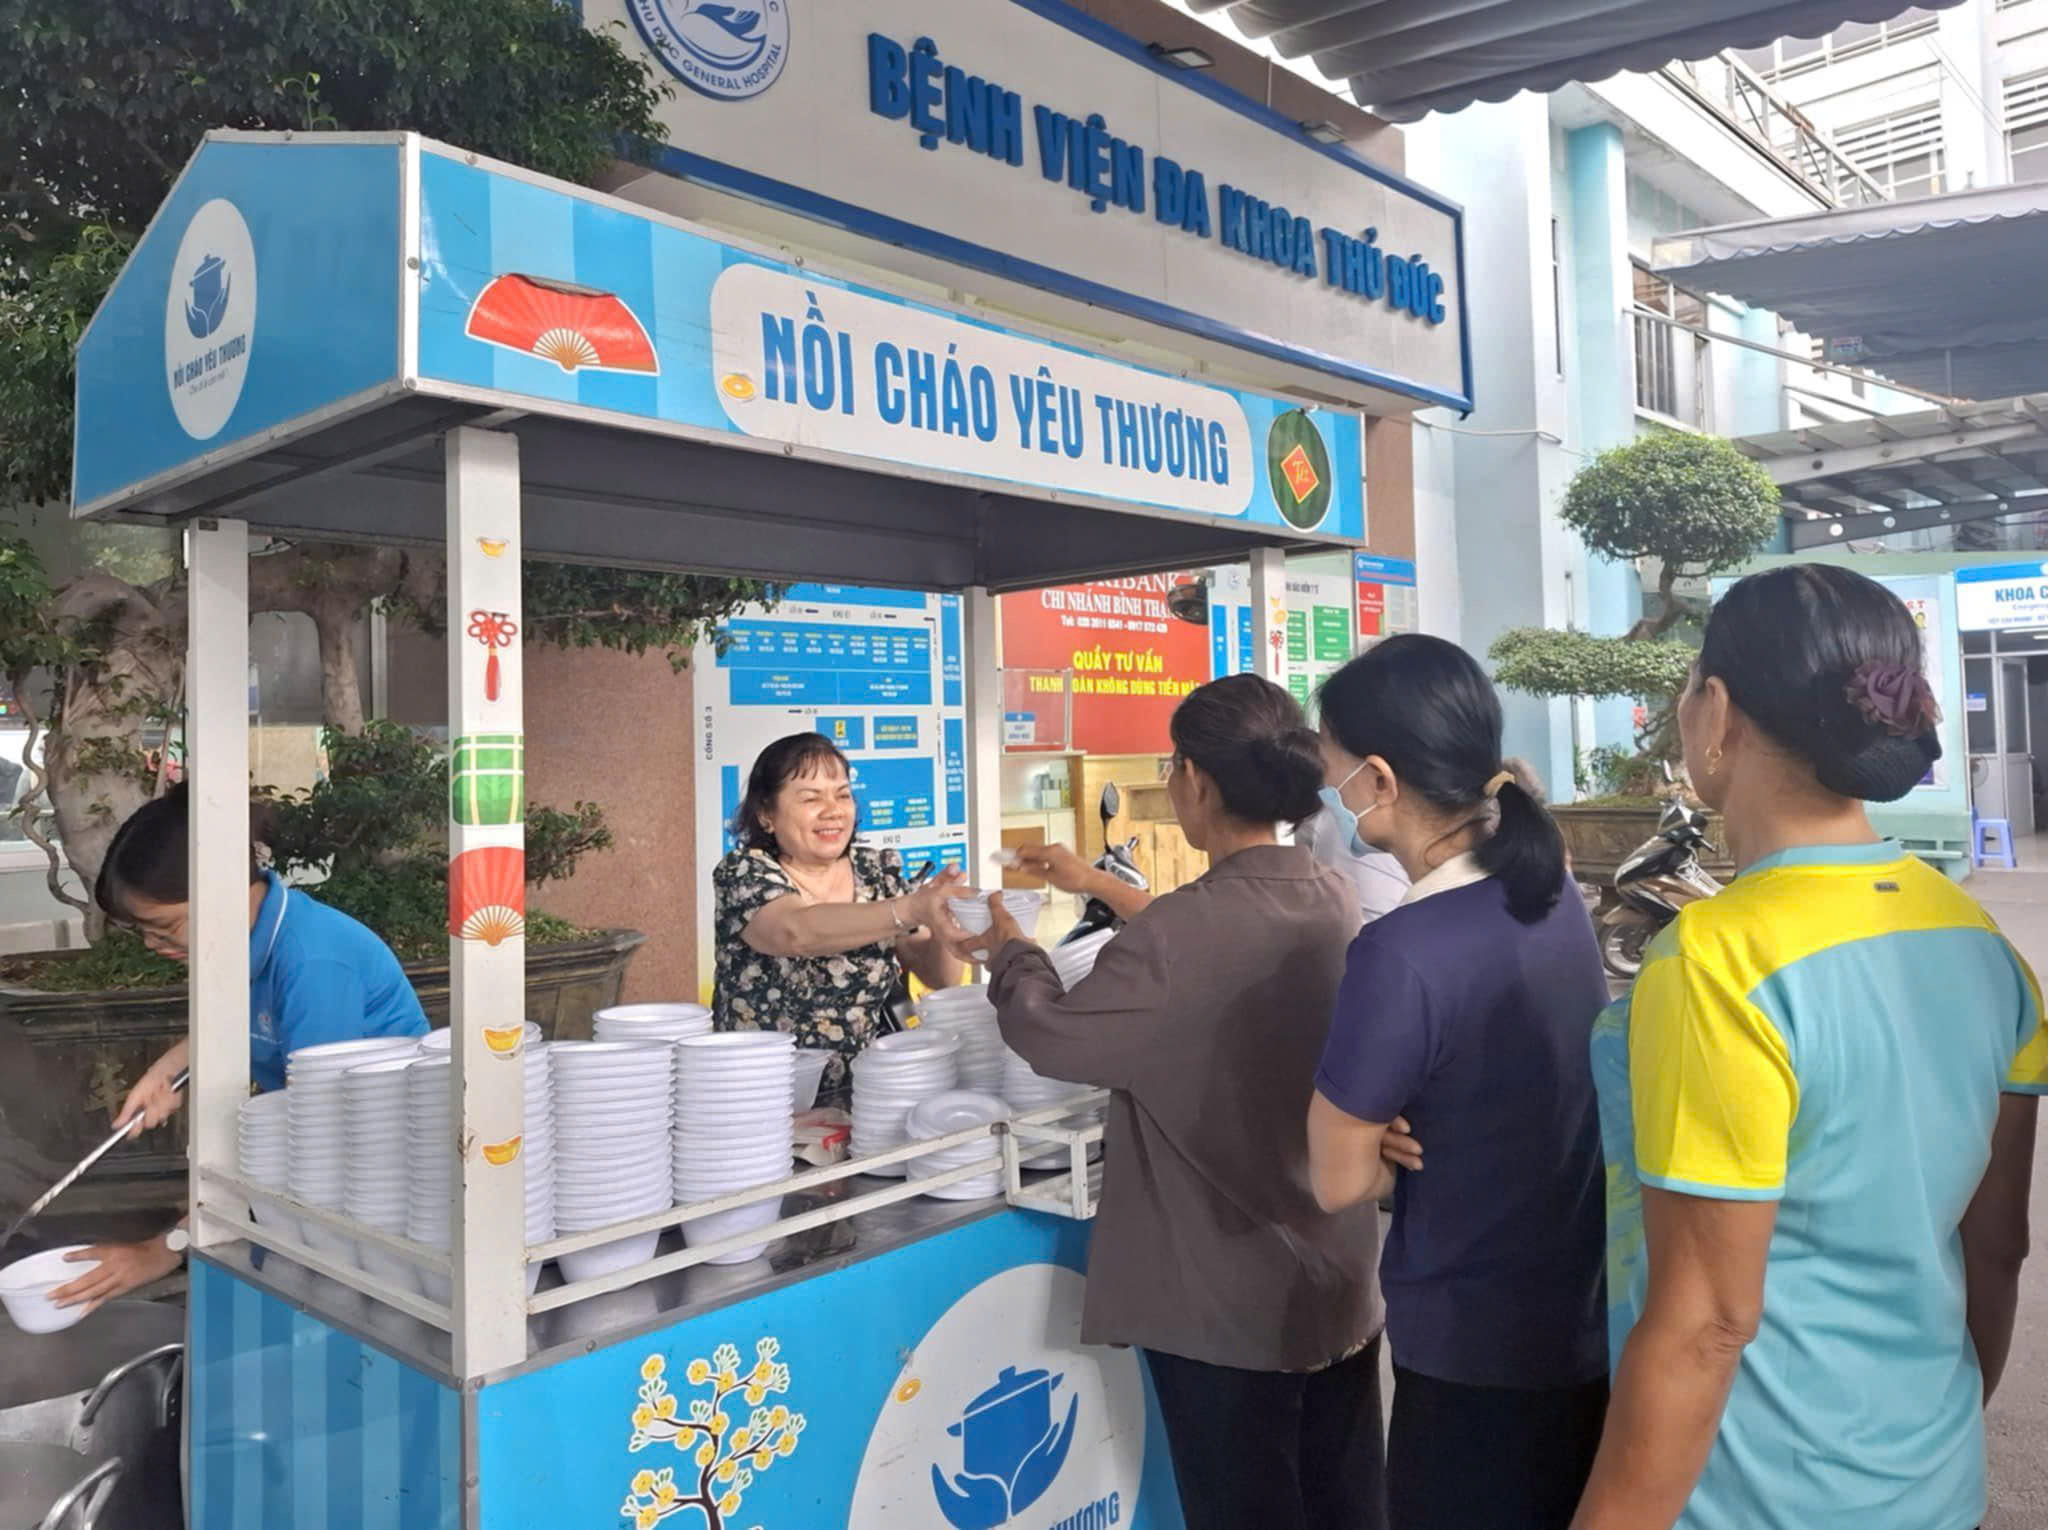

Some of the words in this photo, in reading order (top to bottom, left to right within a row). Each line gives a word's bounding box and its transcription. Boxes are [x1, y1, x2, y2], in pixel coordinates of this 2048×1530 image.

[682, 59, 741, 90] GENERAL
[743, 43, 781, 87] HOSPITAL
[867, 32, 1024, 167] BỆNH
[1033, 104, 1146, 214] VIỆN
[1152, 155, 1212, 239] ĐA
[1218, 184, 1319, 279] KHOA
[1320, 226, 1385, 300] THỦ
[1384, 254, 1446, 326] ĐỨC
[761, 290, 855, 416] NỒI
[874, 342, 998, 443] CHÁO
[1009, 365, 1084, 460] YÊU
[1094, 394, 1230, 487] THƯƠNG
[1041, 589, 1064, 609] CHI
[1067, 588, 1112, 614] NHÁNH
[1113, 591, 1142, 616] BÌNH
[1995, 586, 2035, 602] KHOA
[1114, 650, 1134, 673] TƯ
[1136, 647, 1163, 673] VẤN
[1029, 676, 1064, 693] THANH
[1071, 675, 1094, 693] OÁN
